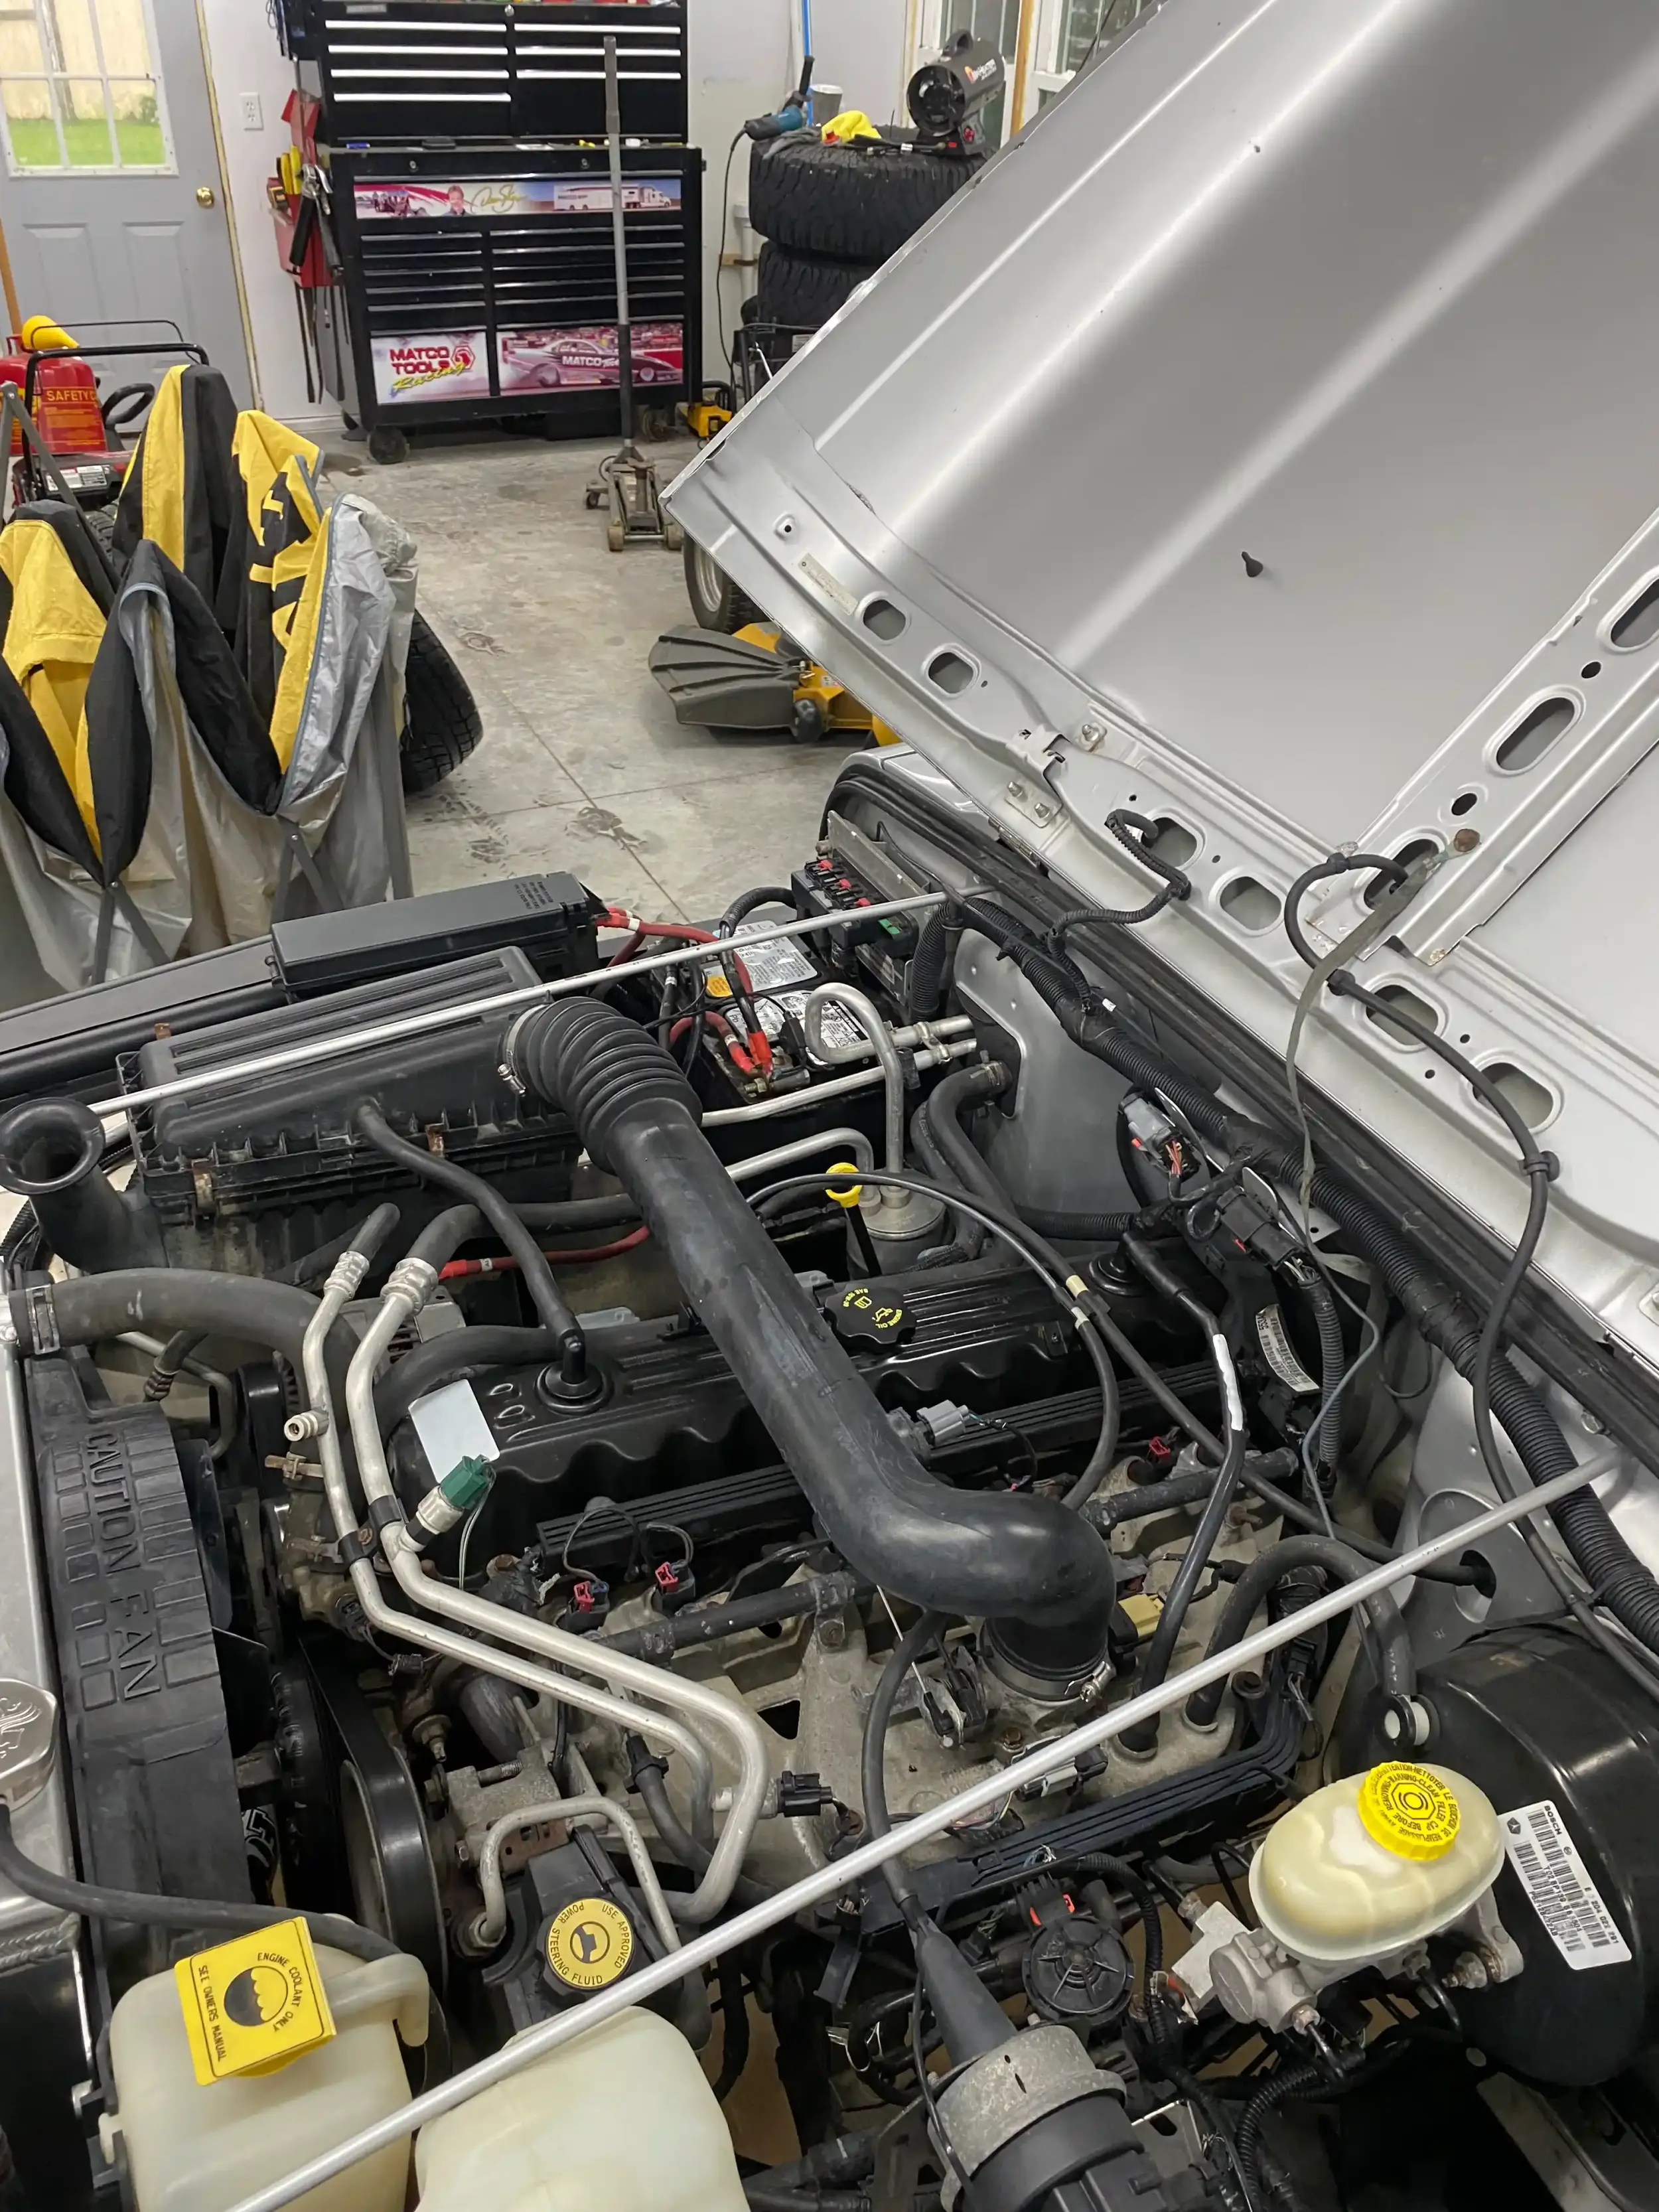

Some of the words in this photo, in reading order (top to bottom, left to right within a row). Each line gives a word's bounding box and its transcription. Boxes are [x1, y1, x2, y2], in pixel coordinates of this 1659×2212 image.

[389, 346, 450, 362] MATCO
[562, 355, 602, 366] MATCO
[391, 360, 451, 375] TOOLS
[46, 390, 88, 402] SAFETY
[87, 1432, 141, 1576] CAUTION
[110, 1590, 161, 1701] FAN
[1393, 1812, 1421, 1831] BEFORE
[1435, 1801, 1446, 1822] FILLER
[1544, 1805, 1562, 1836] BOSCH
[1426, 1820, 1439, 1831] CAP
[557, 1901, 585, 1924] POWER
[601, 1903, 618, 1919] USE
[614, 1921, 630, 1968] APPROVED
[257, 1952, 290, 1967] ENGINE
[549, 1928, 570, 1976] STEERING
[198, 1964, 210, 1982] SEE
[571, 1973, 603, 1985] FLUID
[289, 1966, 303, 2007] COOLANT
[203, 1986, 219, 2022] OWNERS
[273, 2011, 294, 2033] ONLY
[212, 2025, 227, 2063] MANUAL
